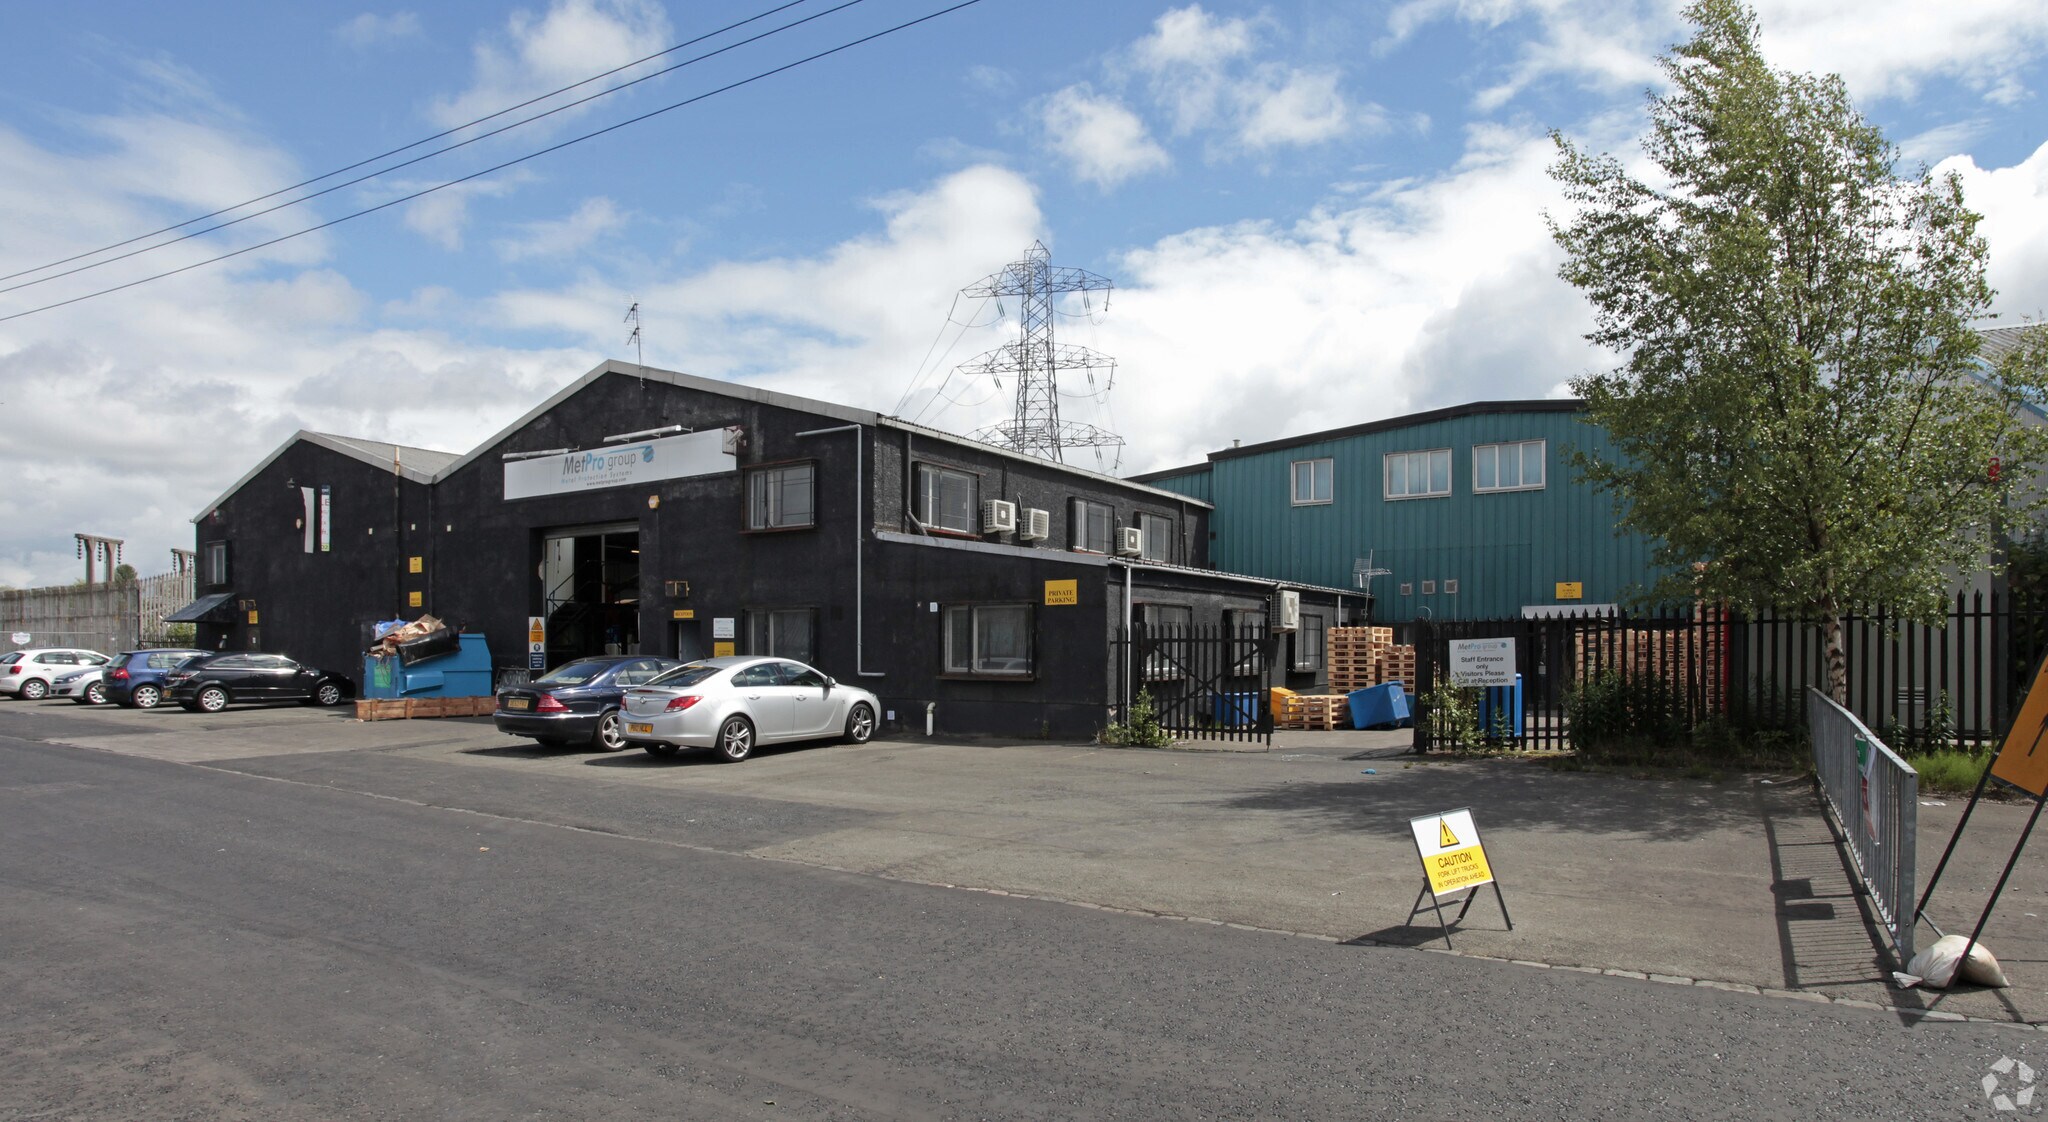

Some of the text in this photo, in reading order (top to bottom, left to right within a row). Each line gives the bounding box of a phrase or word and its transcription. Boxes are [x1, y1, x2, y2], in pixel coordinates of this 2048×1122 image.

[563, 452, 636, 475] MetPro group
[610, 470, 633, 479] Systems
[1438, 852, 1472, 868] CAUTION
[1461, 863, 1479, 872] TRUCKS
[1444, 875, 1469, 887] OPERATION
[1470, 870, 1485, 880] AHEAD
